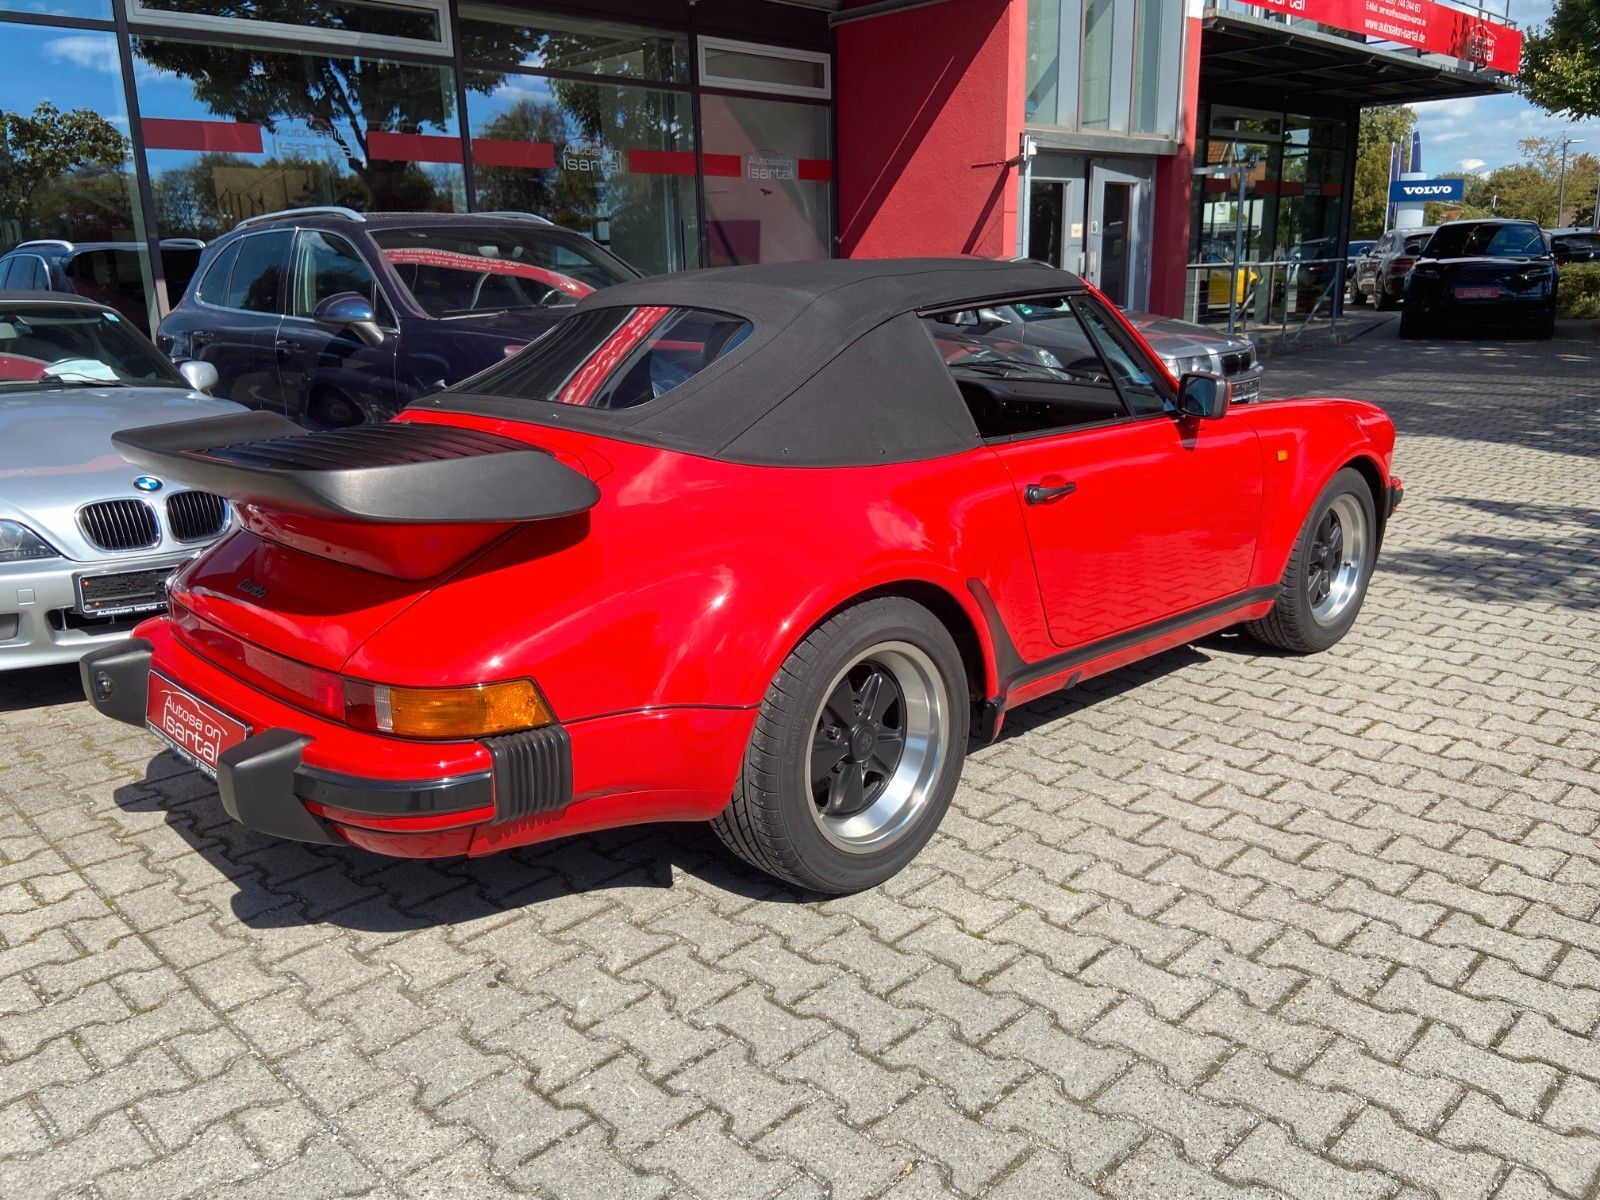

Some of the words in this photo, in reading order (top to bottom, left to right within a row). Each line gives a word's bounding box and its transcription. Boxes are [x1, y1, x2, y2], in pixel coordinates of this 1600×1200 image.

[562, 155, 622, 173] Isartal
[747, 160, 793, 180] Isartal
[1403, 185, 1452, 195] VOLVO
[97, 607, 133, 616] Autosalon
[134, 603, 157, 611] Isartal
[162, 706, 220, 765] Isartal
